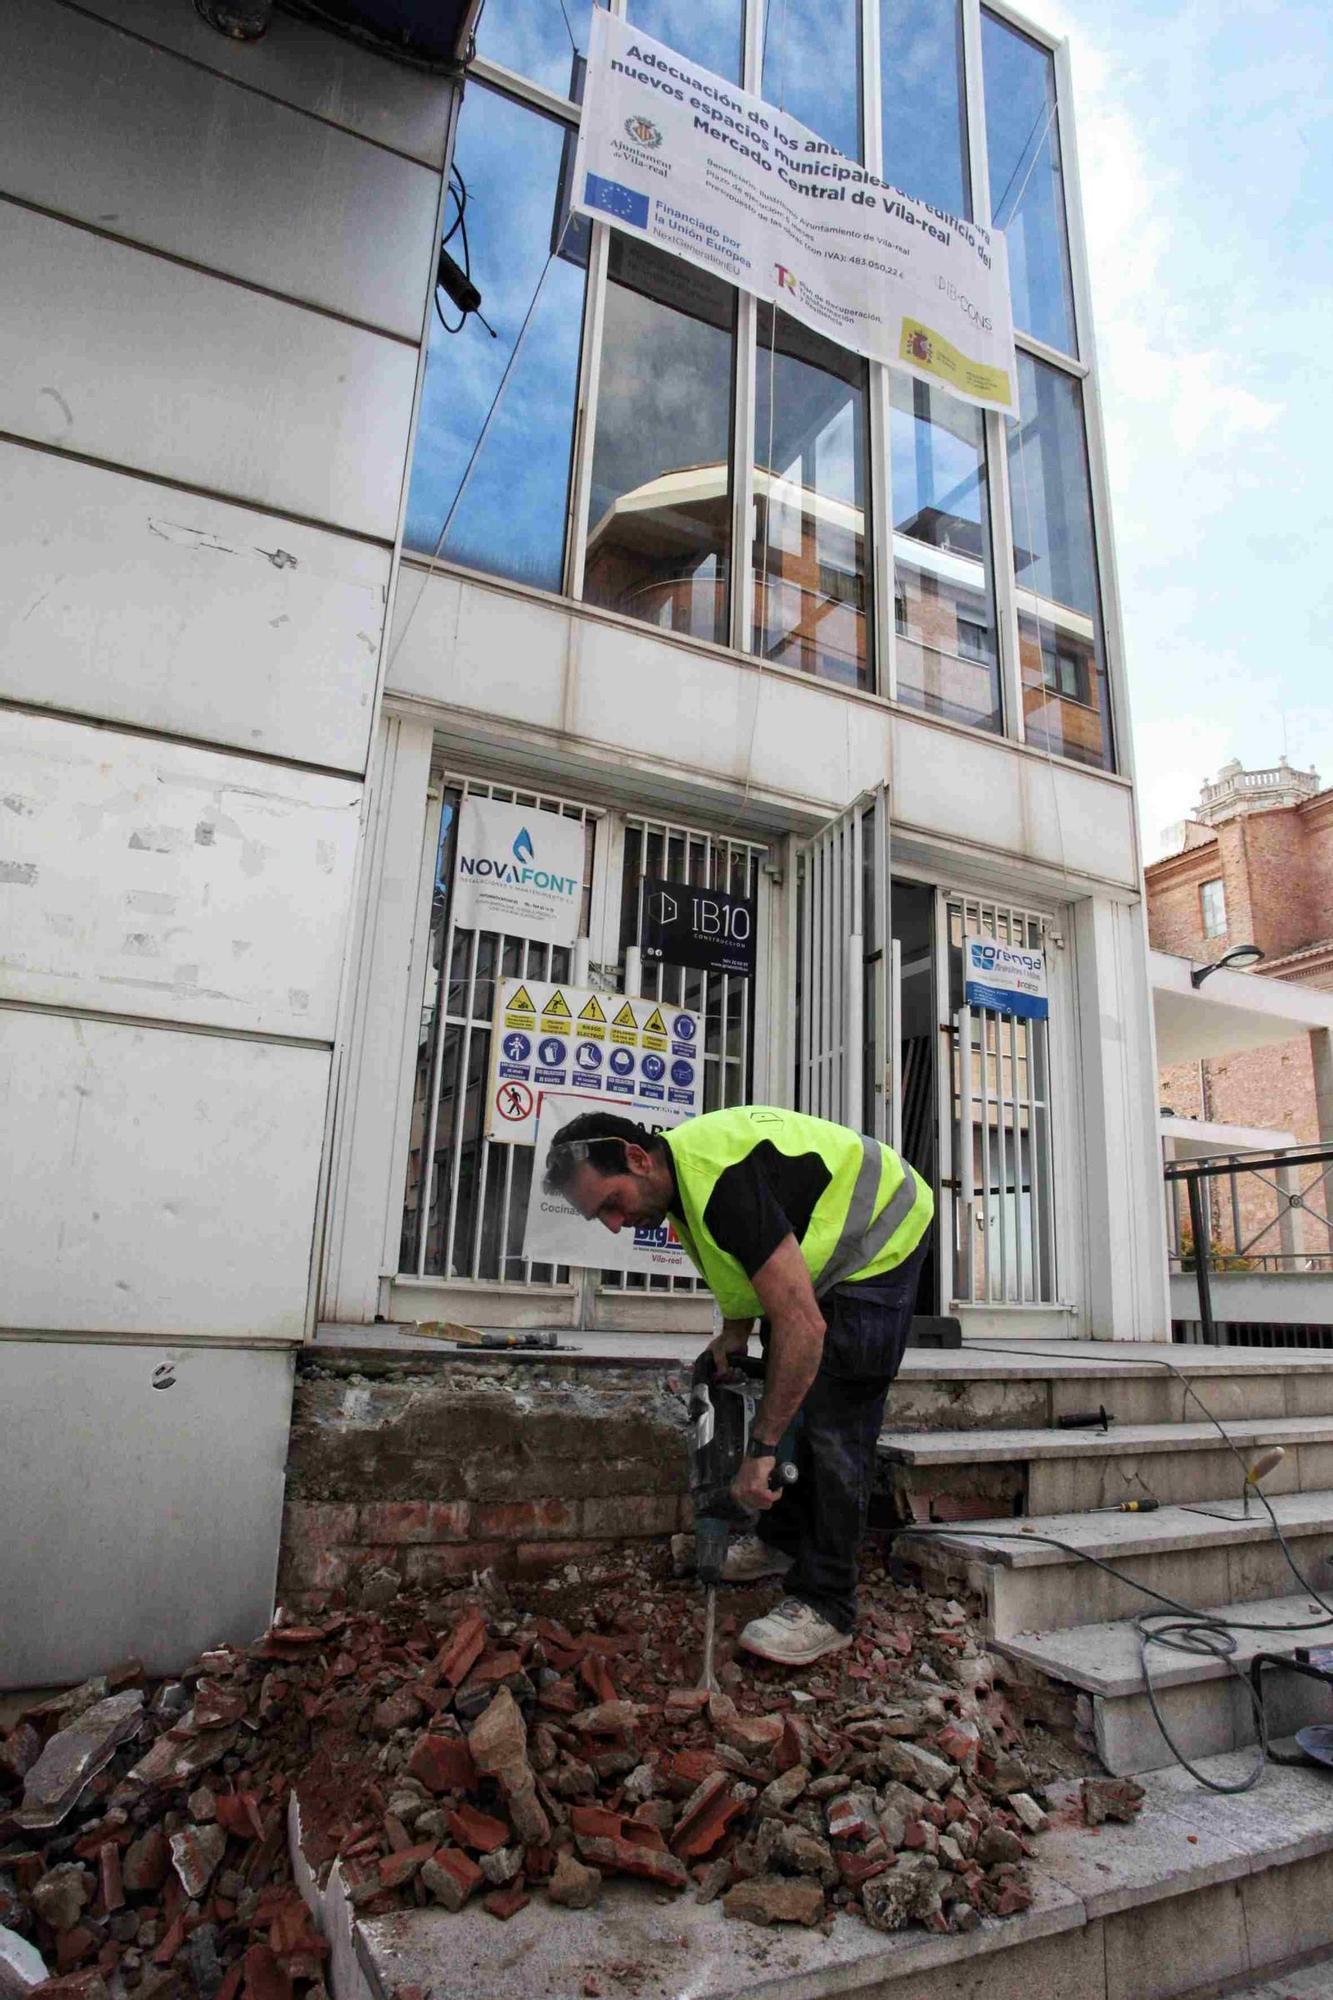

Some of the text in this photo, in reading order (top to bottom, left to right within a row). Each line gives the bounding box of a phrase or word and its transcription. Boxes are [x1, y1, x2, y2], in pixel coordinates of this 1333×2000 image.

[626, 45, 743, 115] Adecuación
[748, 108, 769, 131] de
[774, 126, 799, 150] los
[610, 59, 685, 102] nuevos
[690, 98, 770, 151] espacios
[774, 147, 890, 190] municipales
[610, 139, 672, 170] Ajuntament
[623, 151, 668, 177] Vila-real
[693, 115, 772, 172] Mercado
[777, 166, 845, 200] Central
[850, 185, 877, 208] de
[882, 197, 951, 247] Vila-real
[706, 169, 731, 185] Plazo
[732, 183, 743, 193] de
[654, 213, 752, 269] la Unión Europea
[655, 200, 742, 249] Financiado por
[705, 180, 757, 214] Presupuesto
[757, 212, 768, 222] de
[824, 251, 847, 262] IVA):
[799, 218, 861, 239] Ayuntamiento
[863, 233, 874, 241] de
[876, 237, 911, 256] Vila-real
[653, 227, 740, 276] NextGenerationEU
[460, 855, 578, 896] NOVAFONT
[692, 898, 750, 940] IB10
[652, 1254, 683, 1264] Vila-real
